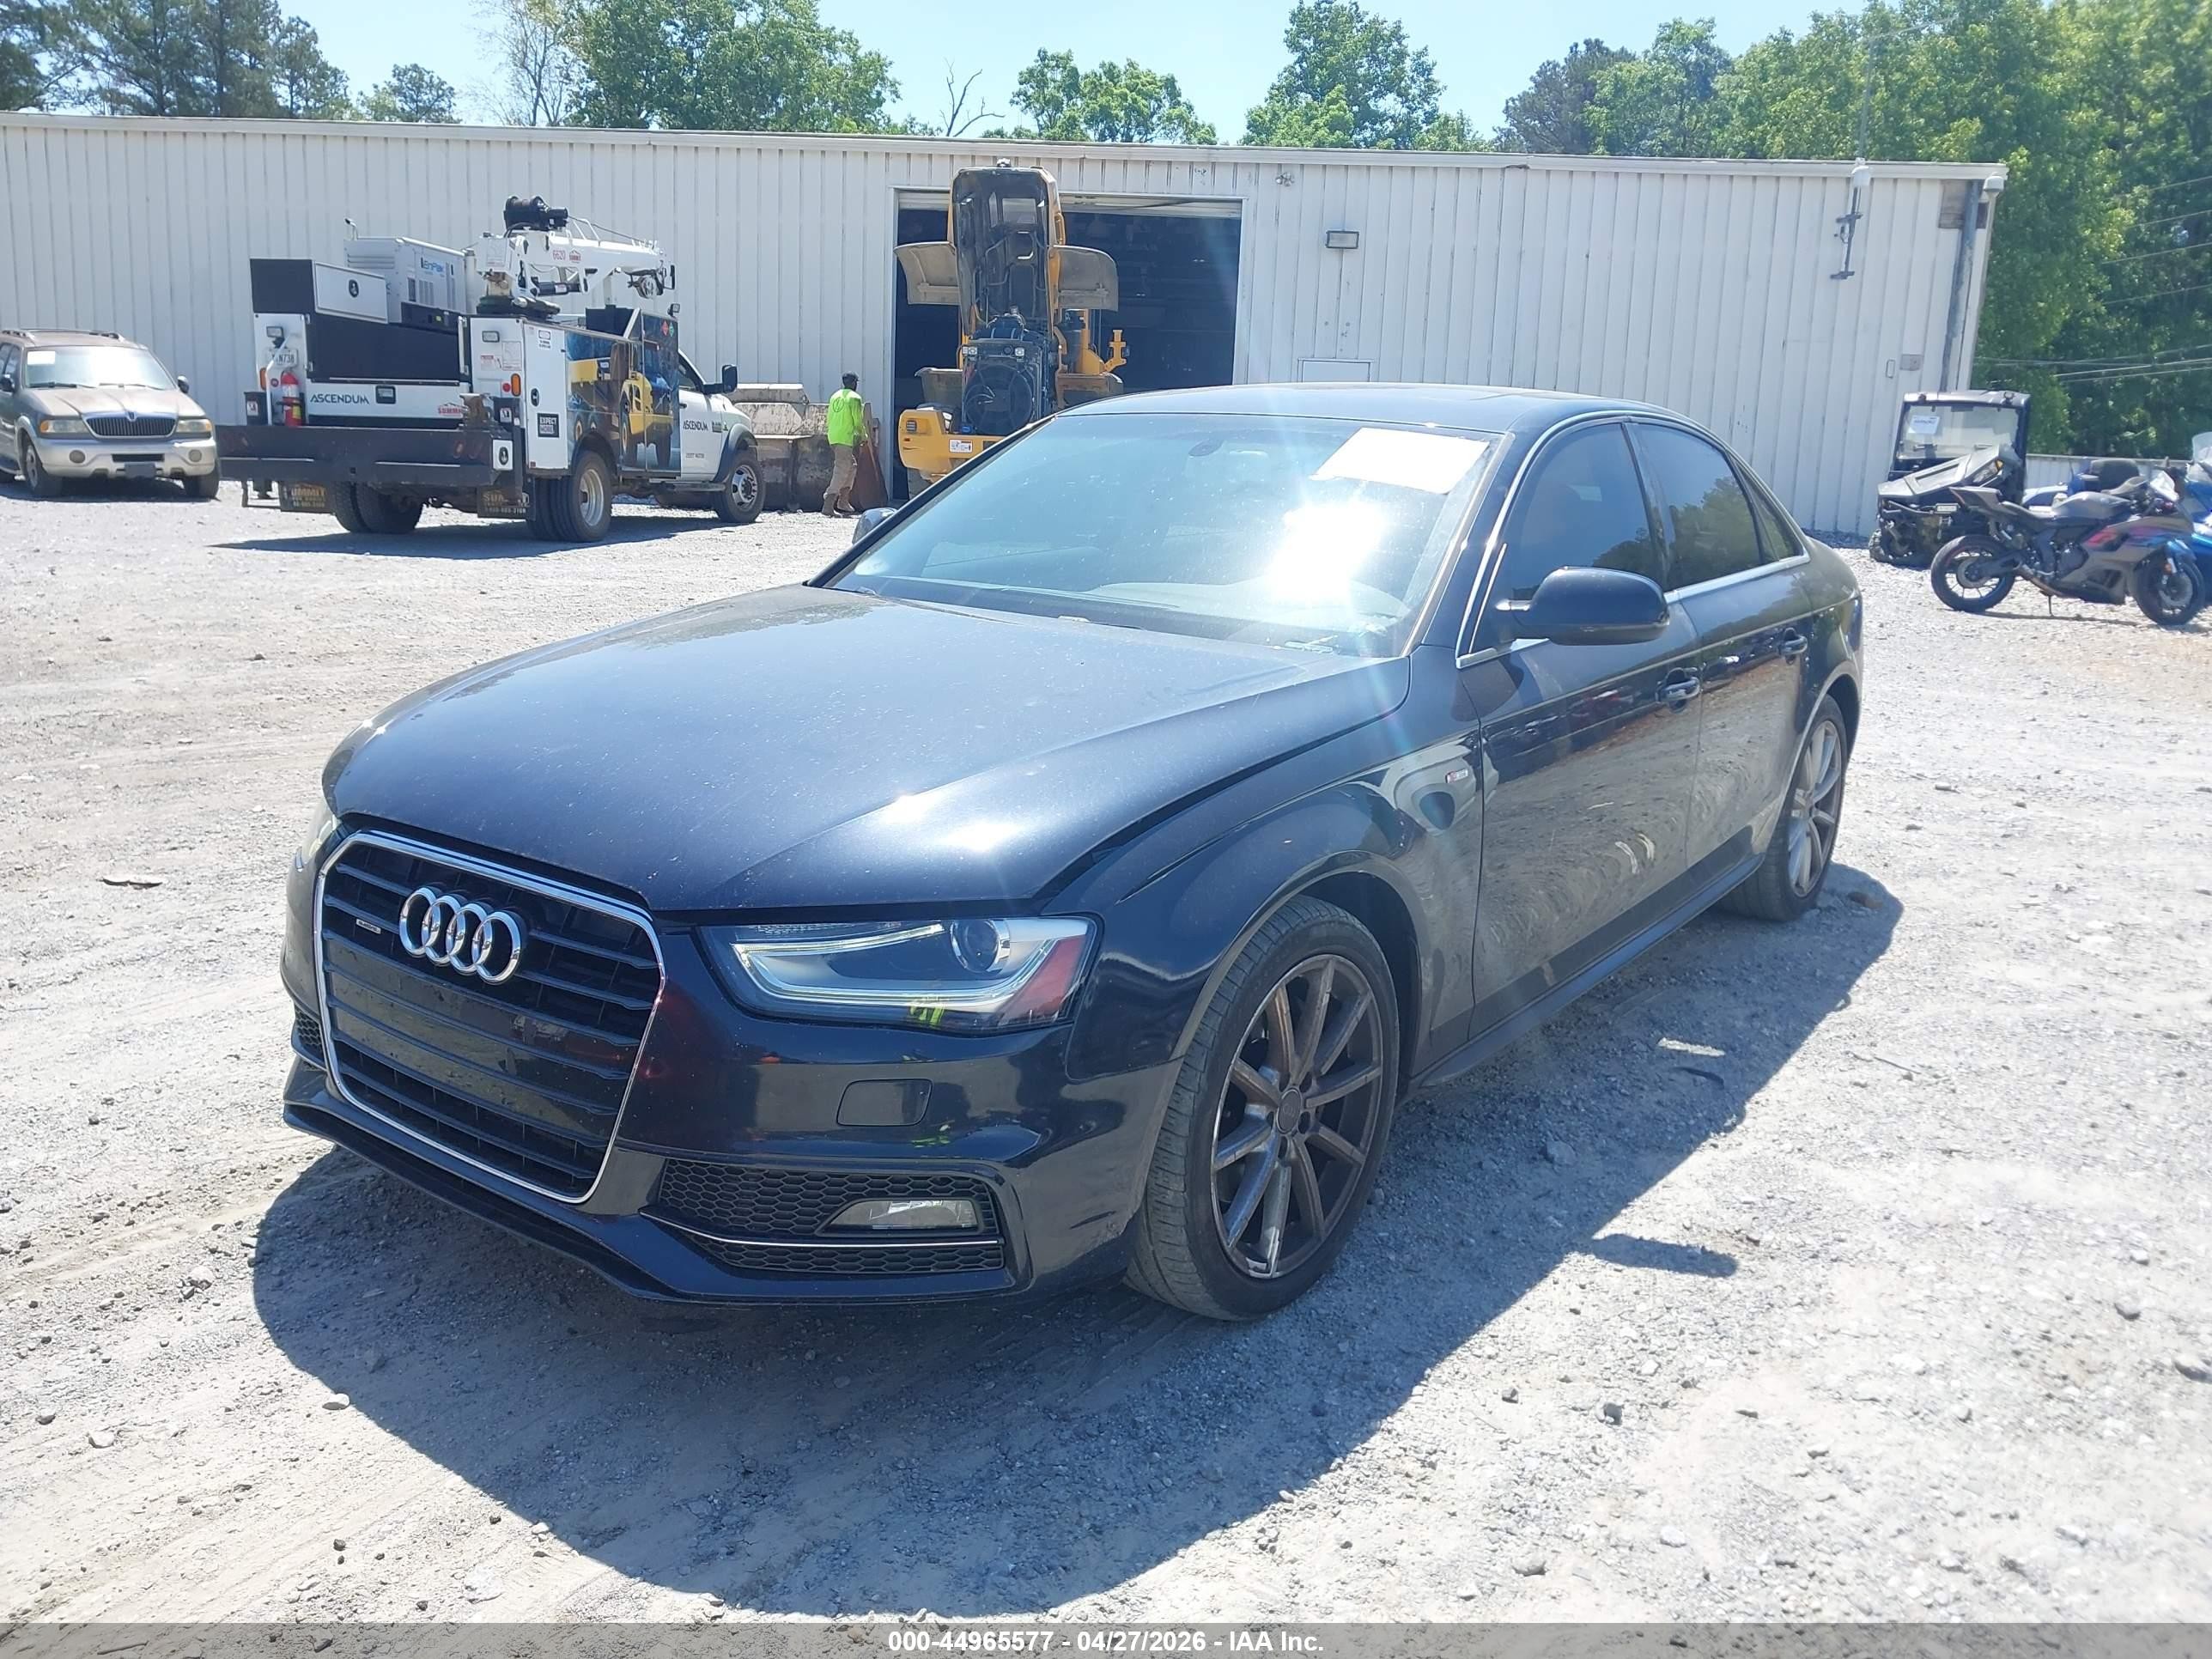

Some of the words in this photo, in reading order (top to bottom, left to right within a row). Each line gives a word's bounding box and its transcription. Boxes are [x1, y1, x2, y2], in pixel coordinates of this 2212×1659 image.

[310, 393, 370, 404] ASCENDUM
[539, 416, 557, 425] EXPECT
[683, 420, 708, 431] ASCENDUM
